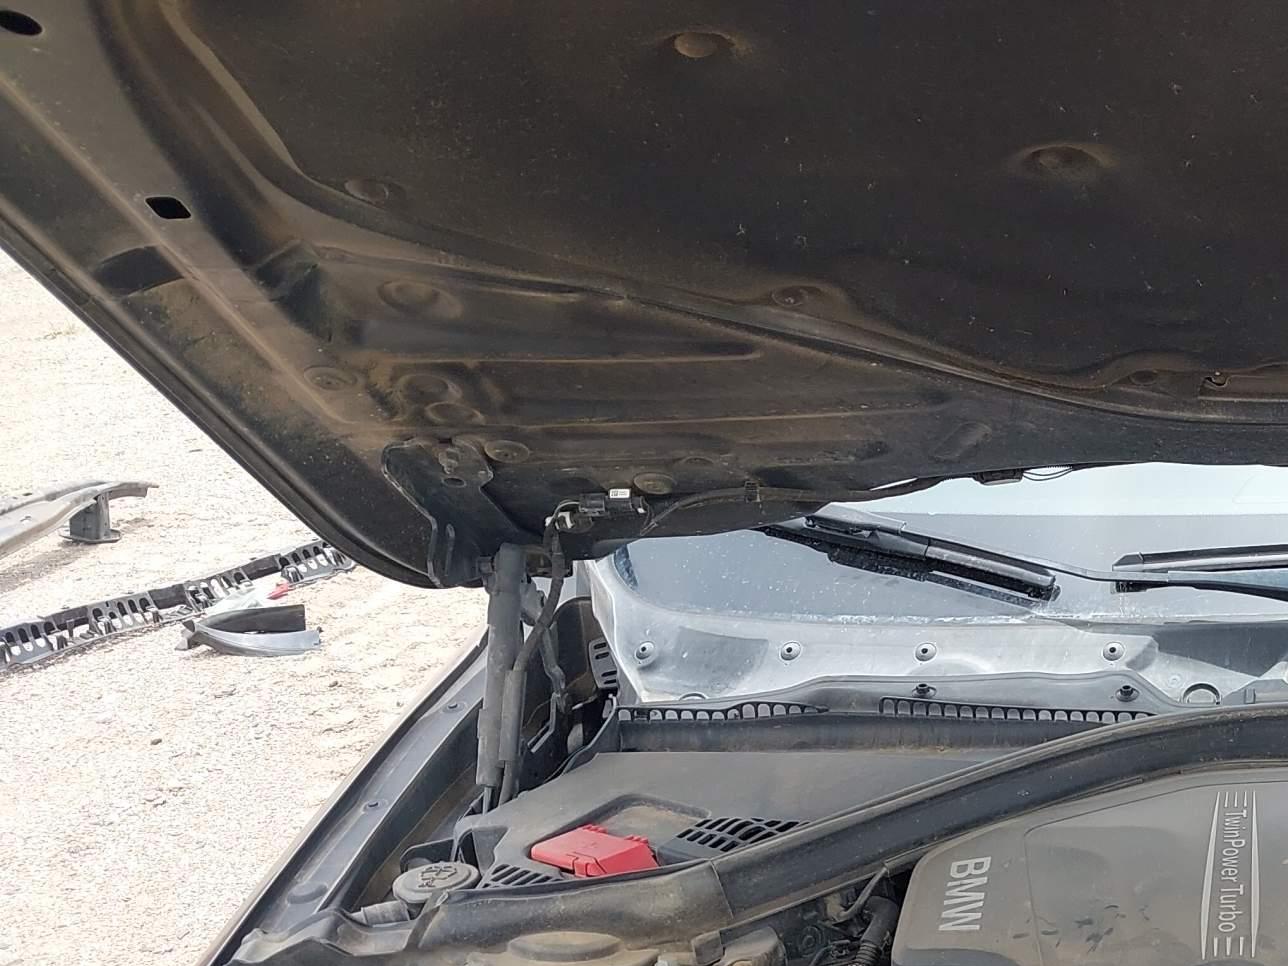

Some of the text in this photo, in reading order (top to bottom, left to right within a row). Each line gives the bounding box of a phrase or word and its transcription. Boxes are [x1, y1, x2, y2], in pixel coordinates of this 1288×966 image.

[938, 856, 992, 932] BMW
[1218, 809, 1248, 933] TwinPower Turbo
